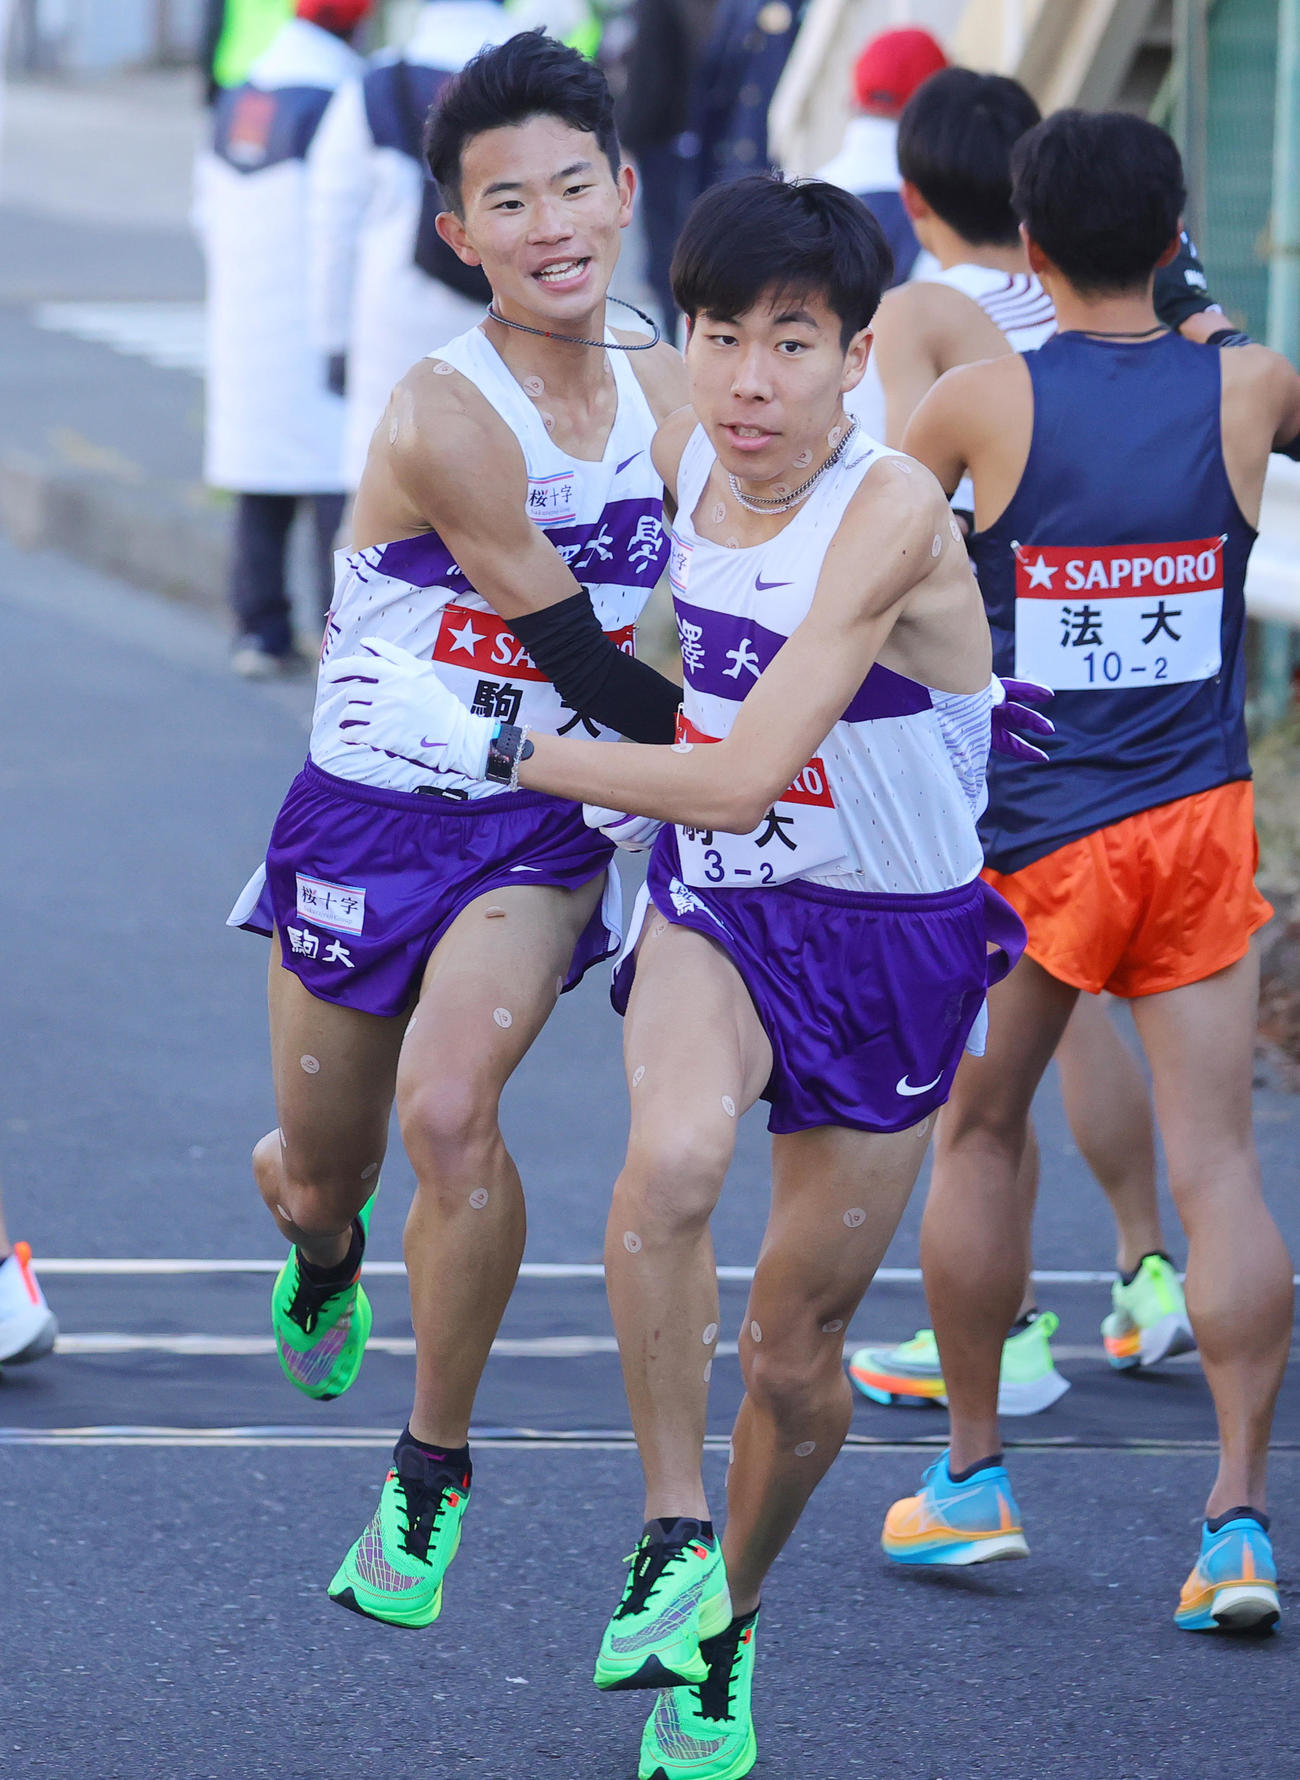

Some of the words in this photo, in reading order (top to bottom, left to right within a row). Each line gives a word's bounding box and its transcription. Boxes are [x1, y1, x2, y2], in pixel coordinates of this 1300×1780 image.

[528, 484, 573, 508] 桜十字
[1065, 554, 1216, 590] SAPPORO
[1060, 600, 1182, 648] 法大
[1083, 650, 1168, 683] 10-2
[704, 849, 777, 885] 3-2
[302, 885, 359, 915] 桜十字
[286, 925, 356, 968] 駒大
